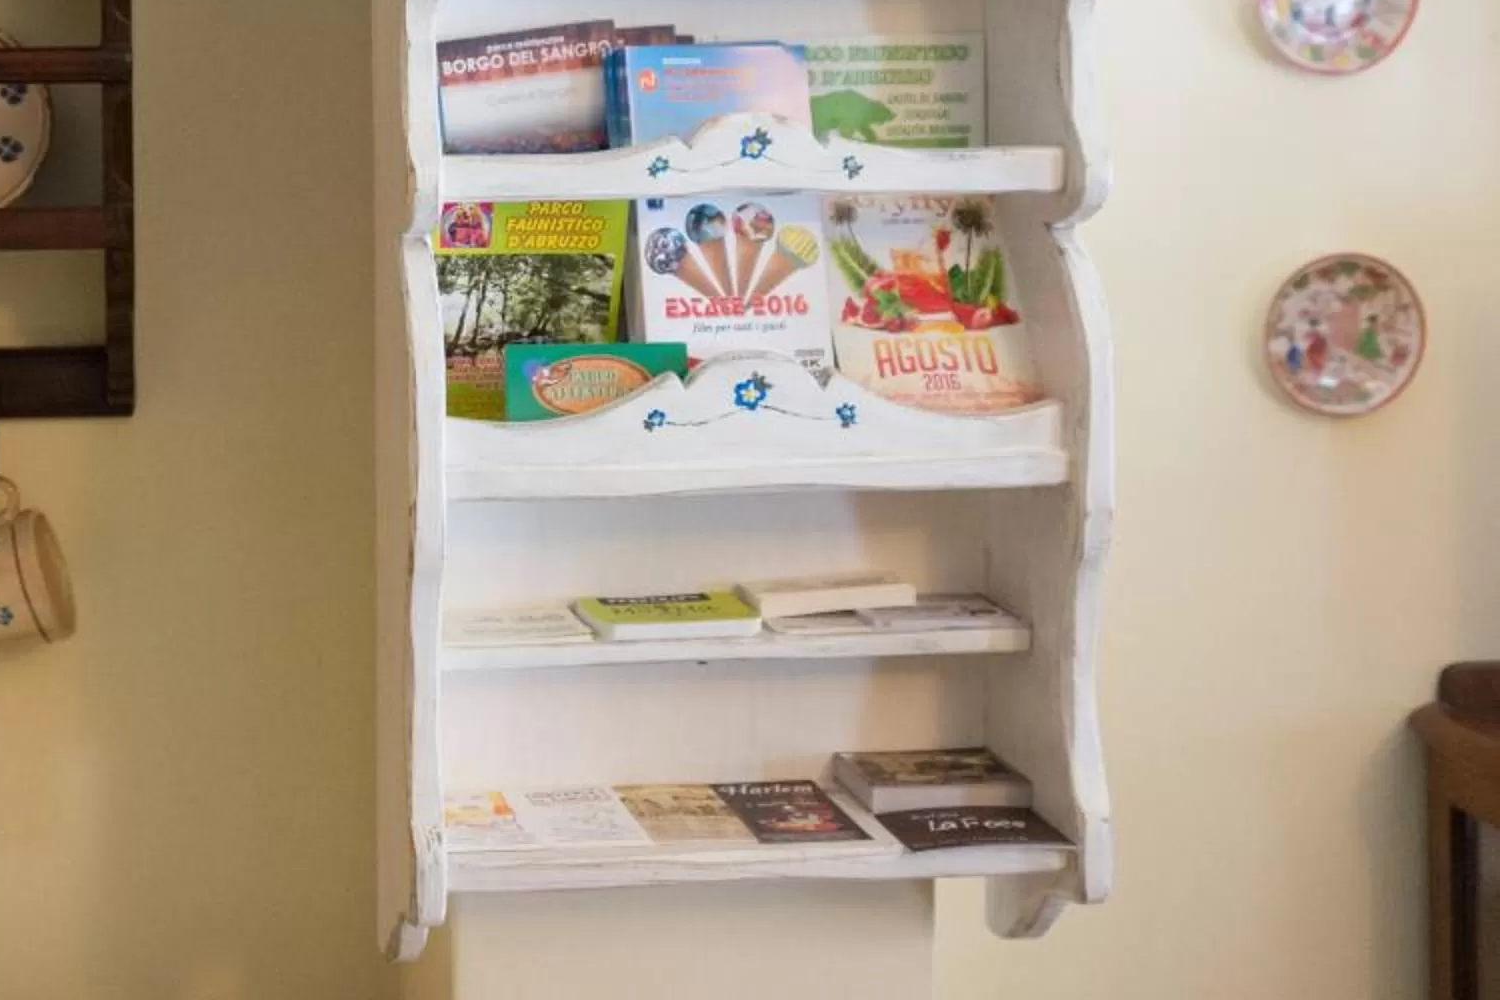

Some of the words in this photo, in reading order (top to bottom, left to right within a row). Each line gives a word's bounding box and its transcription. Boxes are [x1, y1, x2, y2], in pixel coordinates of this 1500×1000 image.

[441, 54, 504, 76] BORGO
[508, 50, 537, 66] DEL
[540, 39, 612, 62] SANGRO
[529, 200, 584, 214] PARCO
[506, 217, 604, 233] FAUNISTICO
[508, 235, 600, 249] D'ABRUZZO
[664, 295, 746, 319] ESTATE
[752, 294, 810, 317] 2016
[715, 323, 731, 336] per
[873, 335, 999, 377] AGOSTO
[923, 374, 962, 392] 2016
